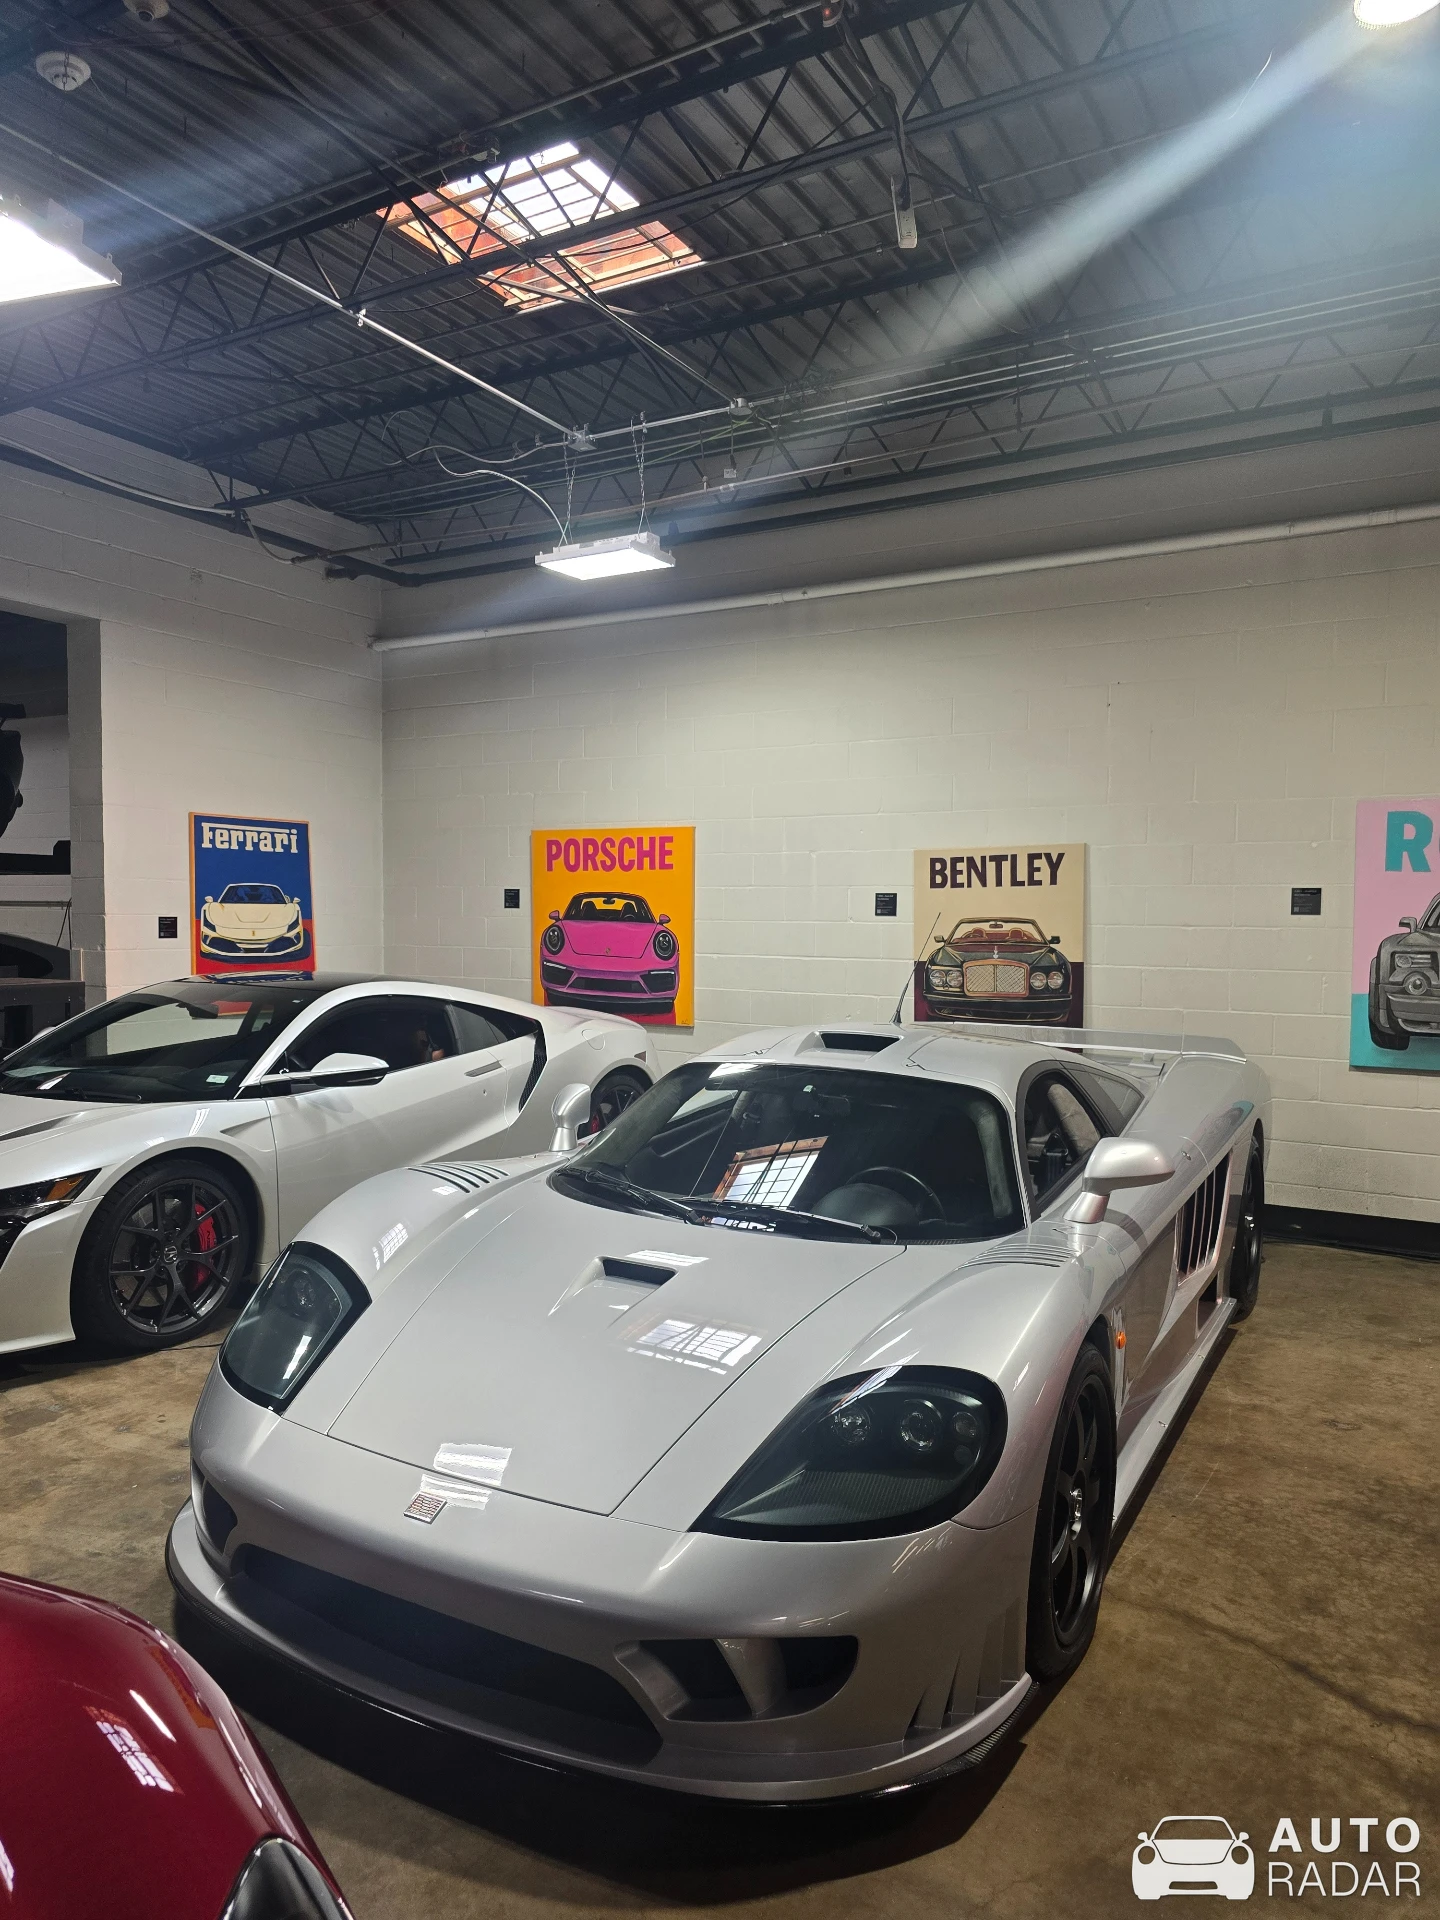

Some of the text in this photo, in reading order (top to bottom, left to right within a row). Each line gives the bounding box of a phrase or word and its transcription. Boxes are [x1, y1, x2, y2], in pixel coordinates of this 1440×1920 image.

[201, 822, 298, 853] Ferrari
[546, 836, 674, 873] PORSCHE
[1385, 811, 1440, 872] R
[929, 852, 1065, 889] BENTLEY
